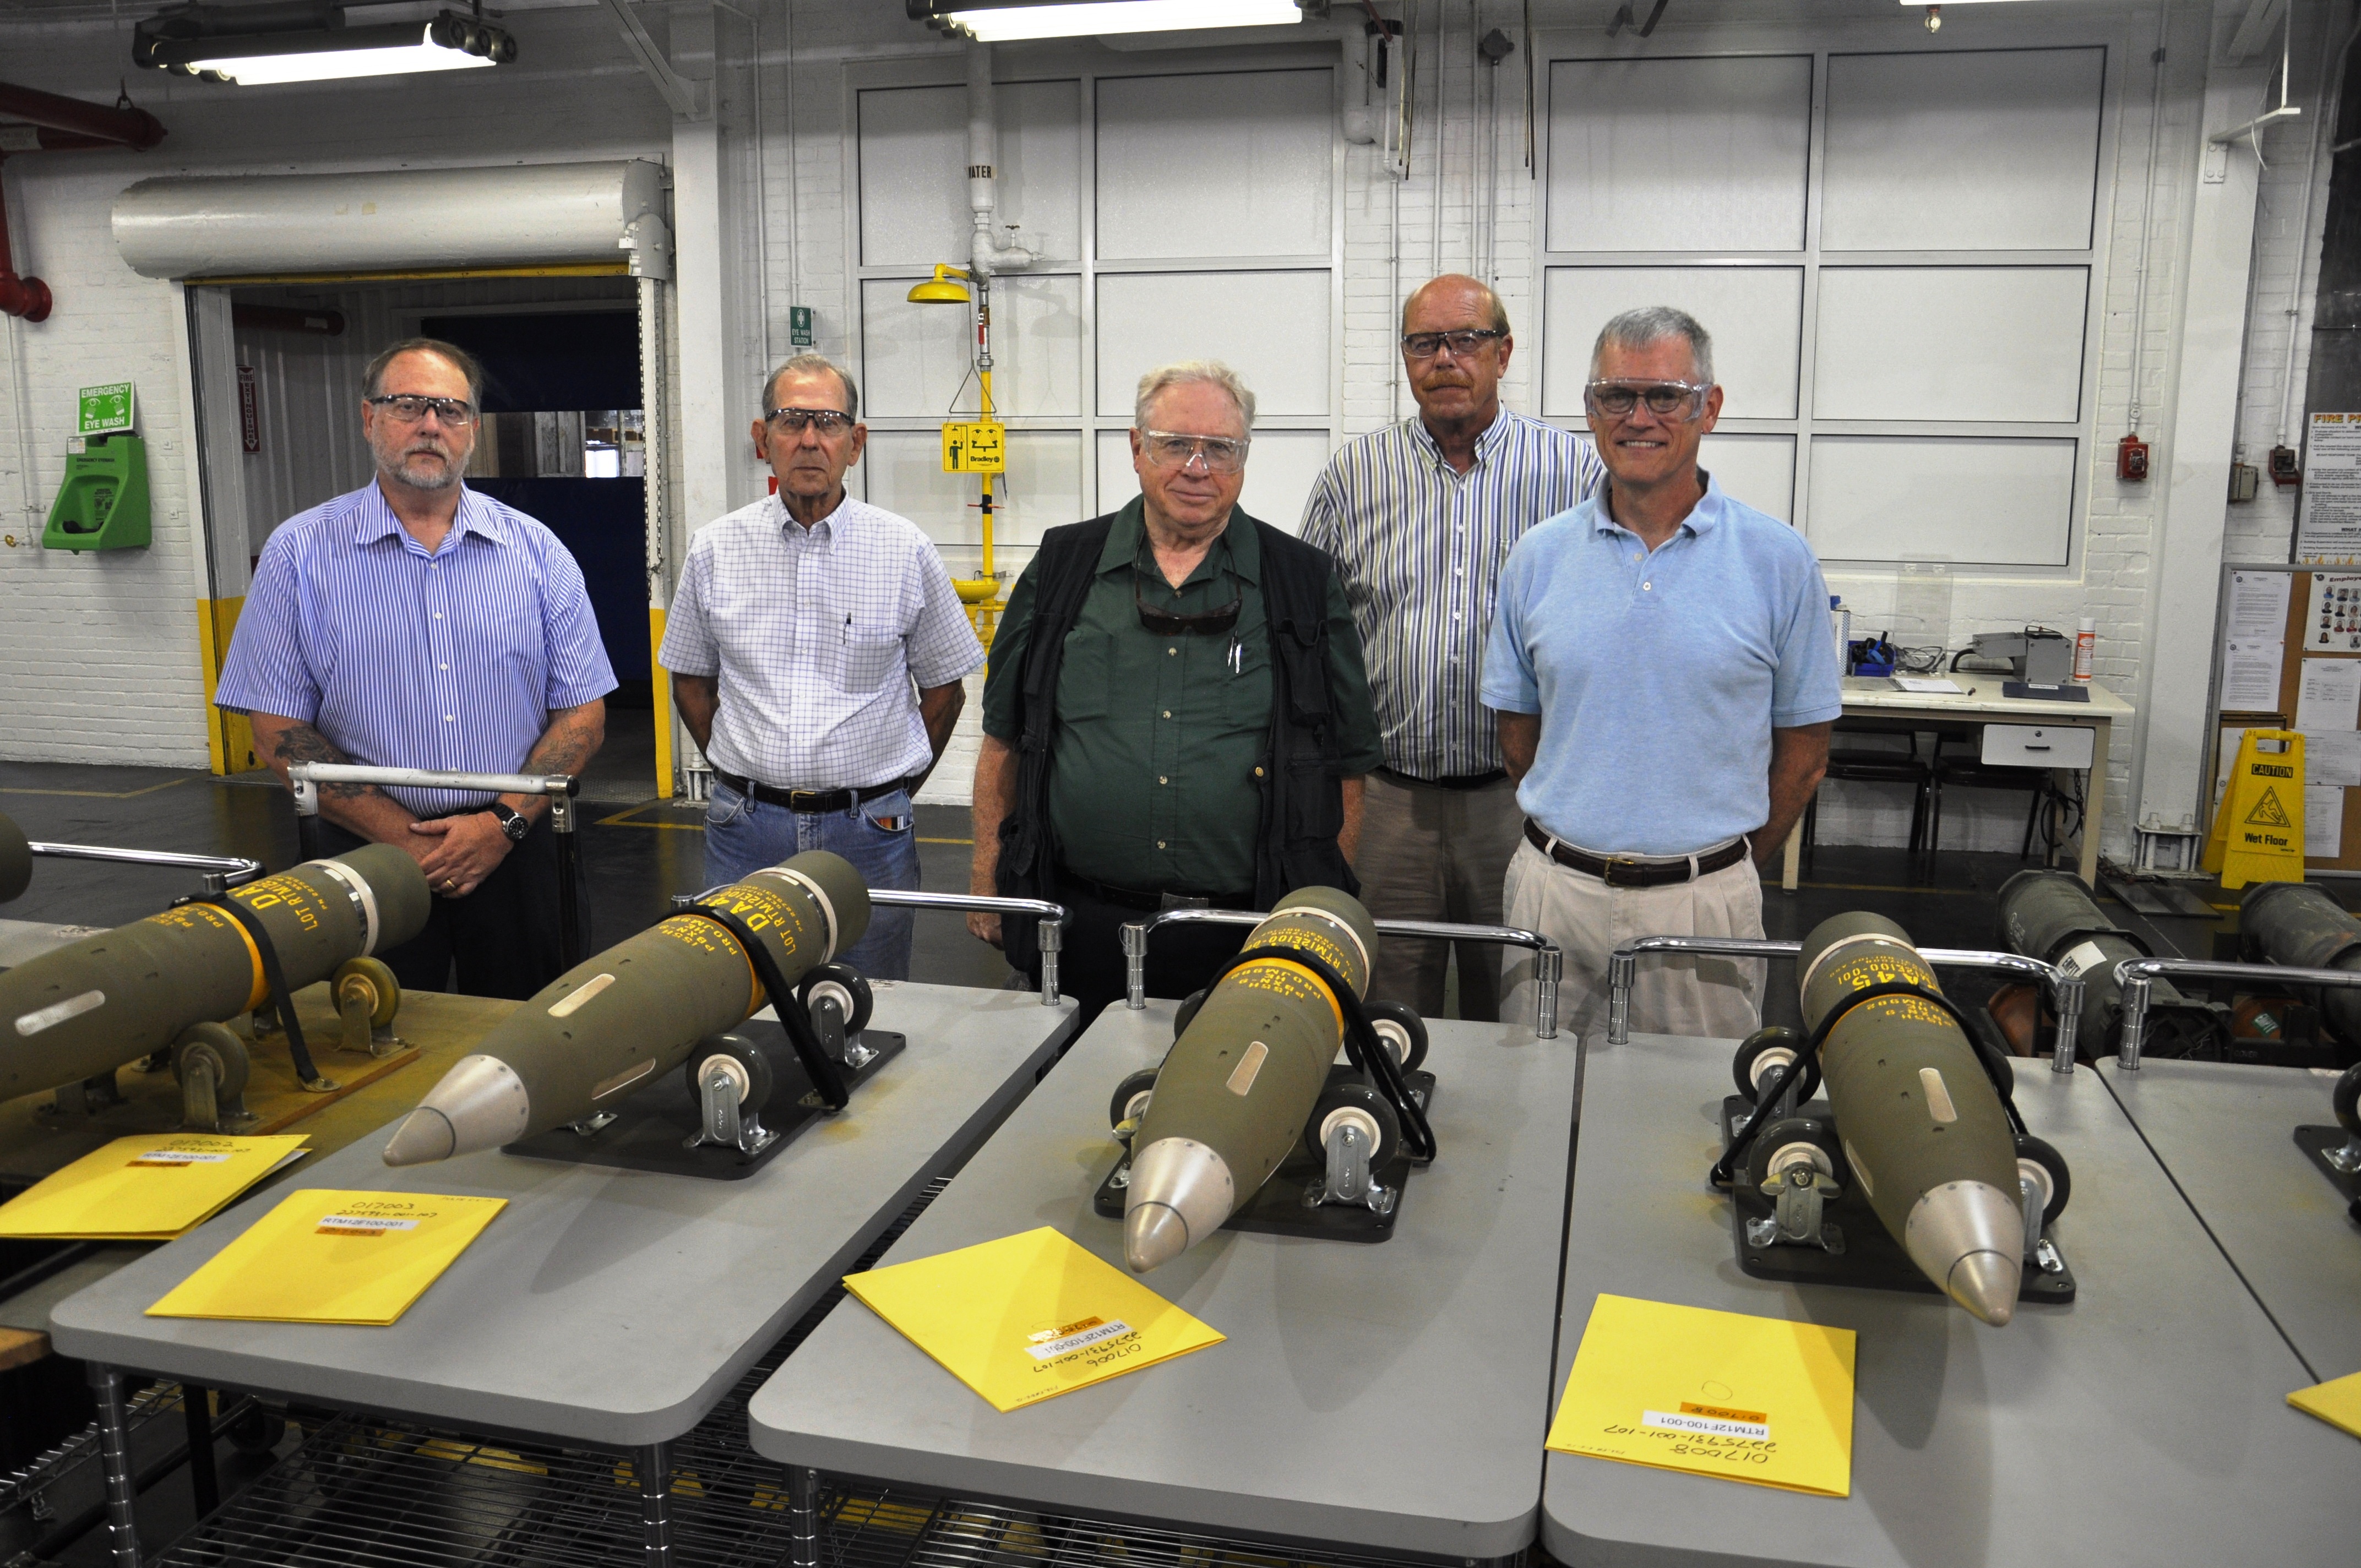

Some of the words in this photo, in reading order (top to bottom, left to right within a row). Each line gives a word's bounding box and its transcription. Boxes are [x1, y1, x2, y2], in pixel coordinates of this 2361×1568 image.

[82, 385, 129, 398] EMERGENCY
[85, 420, 100, 429] EYE
[102, 417, 125, 427] WASH
[245, 383, 254, 444] EXTINGUISHER
[2314, 414, 2343, 423] FIRE
[2253, 764, 2292, 777] CAUTION
[2245, 832, 2261, 843] Wet
[2265, 835, 2288, 846] Floor
[228, 888, 281, 910] DA
[780, 930, 796, 955] LOT
[2062, 956, 2081, 976] EMPTY
[1045, 1323, 1126, 1354] RTM12F100-001
[1033, 1331, 1142, 1373] 2275931-001-107
[1087, 1343, 1141, 1367] 017006
[1660, 1417, 1765, 1436] RTM12F100-001
[1603, 1424, 1777, 1453] 2275931-001-107
[1669, 1444, 1769, 1463] 017008
